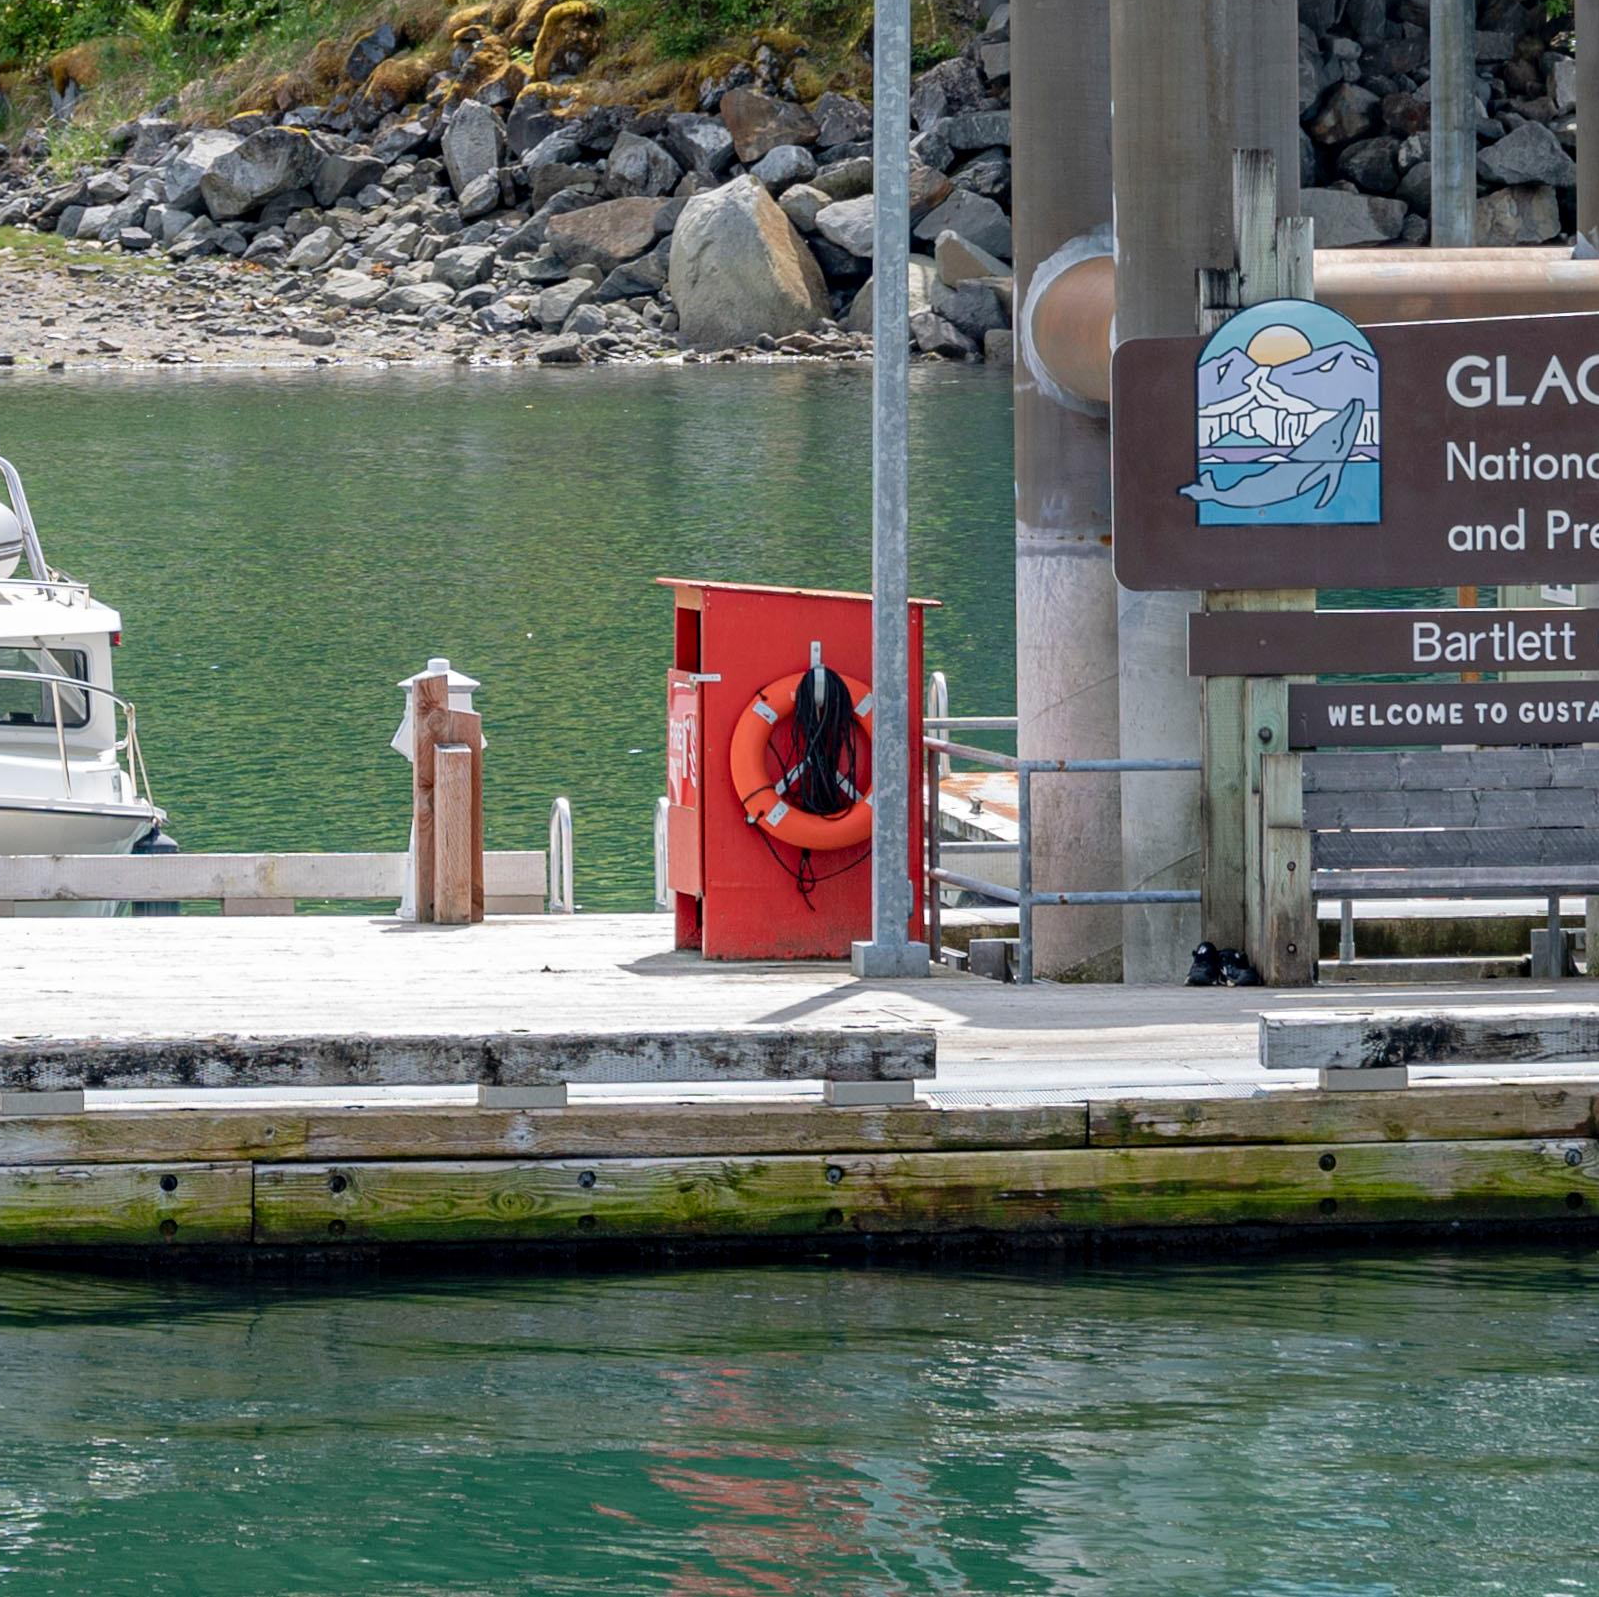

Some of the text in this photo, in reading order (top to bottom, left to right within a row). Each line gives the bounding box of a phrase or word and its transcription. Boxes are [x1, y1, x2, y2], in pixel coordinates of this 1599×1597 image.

[1447, 507, 1526, 552] and
[1412, 621, 1576, 663] Bartlett
[1328, 703, 1464, 727] WELCOME
[1474, 702, 1508, 724] TO
